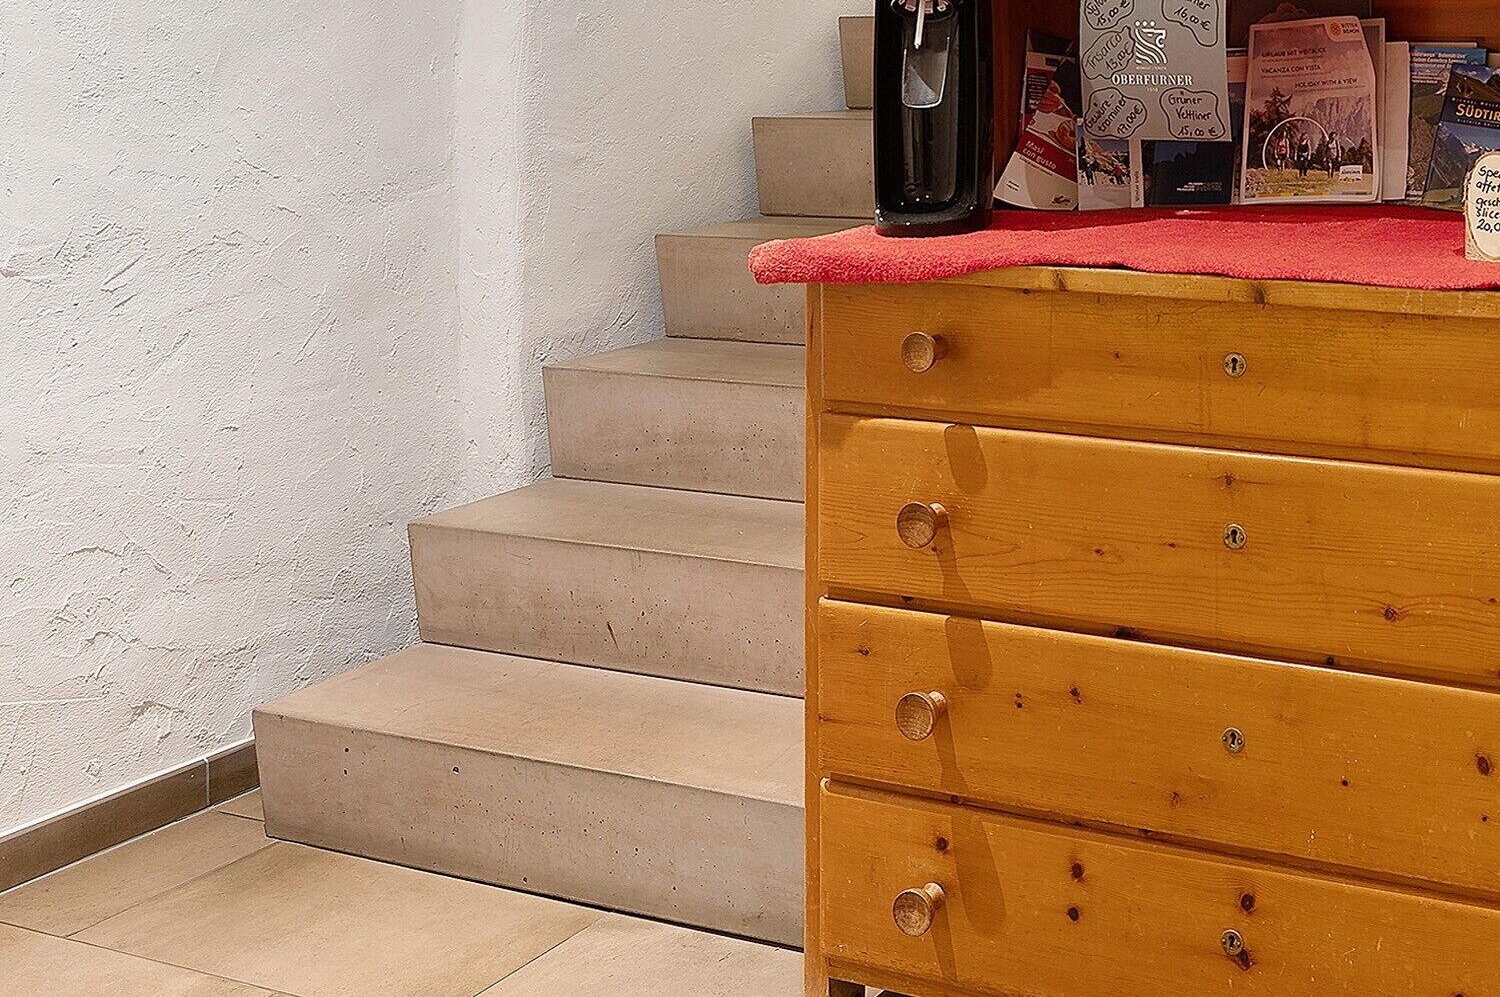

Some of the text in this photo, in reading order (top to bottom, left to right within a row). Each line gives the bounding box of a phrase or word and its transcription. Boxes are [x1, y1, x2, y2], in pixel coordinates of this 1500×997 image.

[1111, 74, 1193, 86] OBERFURNER
[1168, 90, 1203, 106] Grüner
[1175, 105, 1212, 121] Veltliner
[1022, 148, 1038, 160] con
[1037, 155, 1057, 170] gusto
